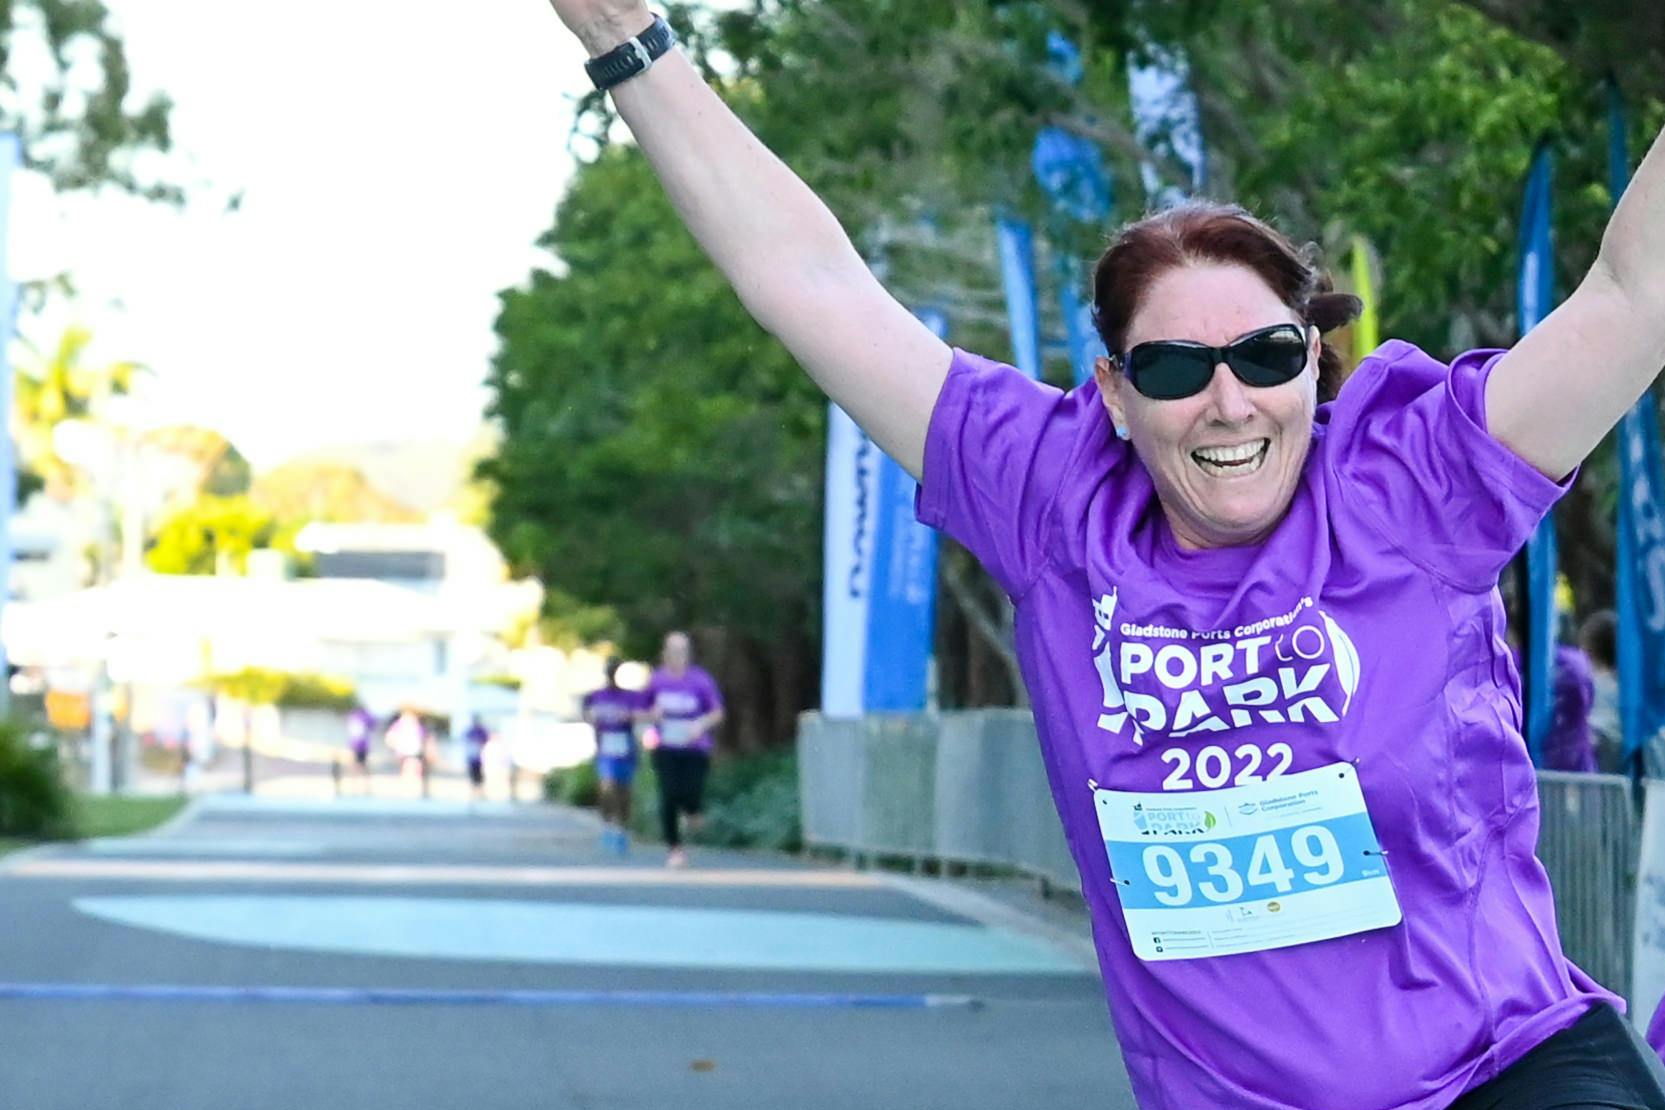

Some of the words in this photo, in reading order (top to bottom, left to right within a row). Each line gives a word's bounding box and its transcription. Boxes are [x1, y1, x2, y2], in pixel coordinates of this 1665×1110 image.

[1120, 622, 1187, 639] Gladstone
[1120, 636, 1272, 689] PORT
[1123, 663, 1340, 746] PARK
[1161, 742, 1293, 790] 2022
[1142, 825, 1345, 906] 9349
